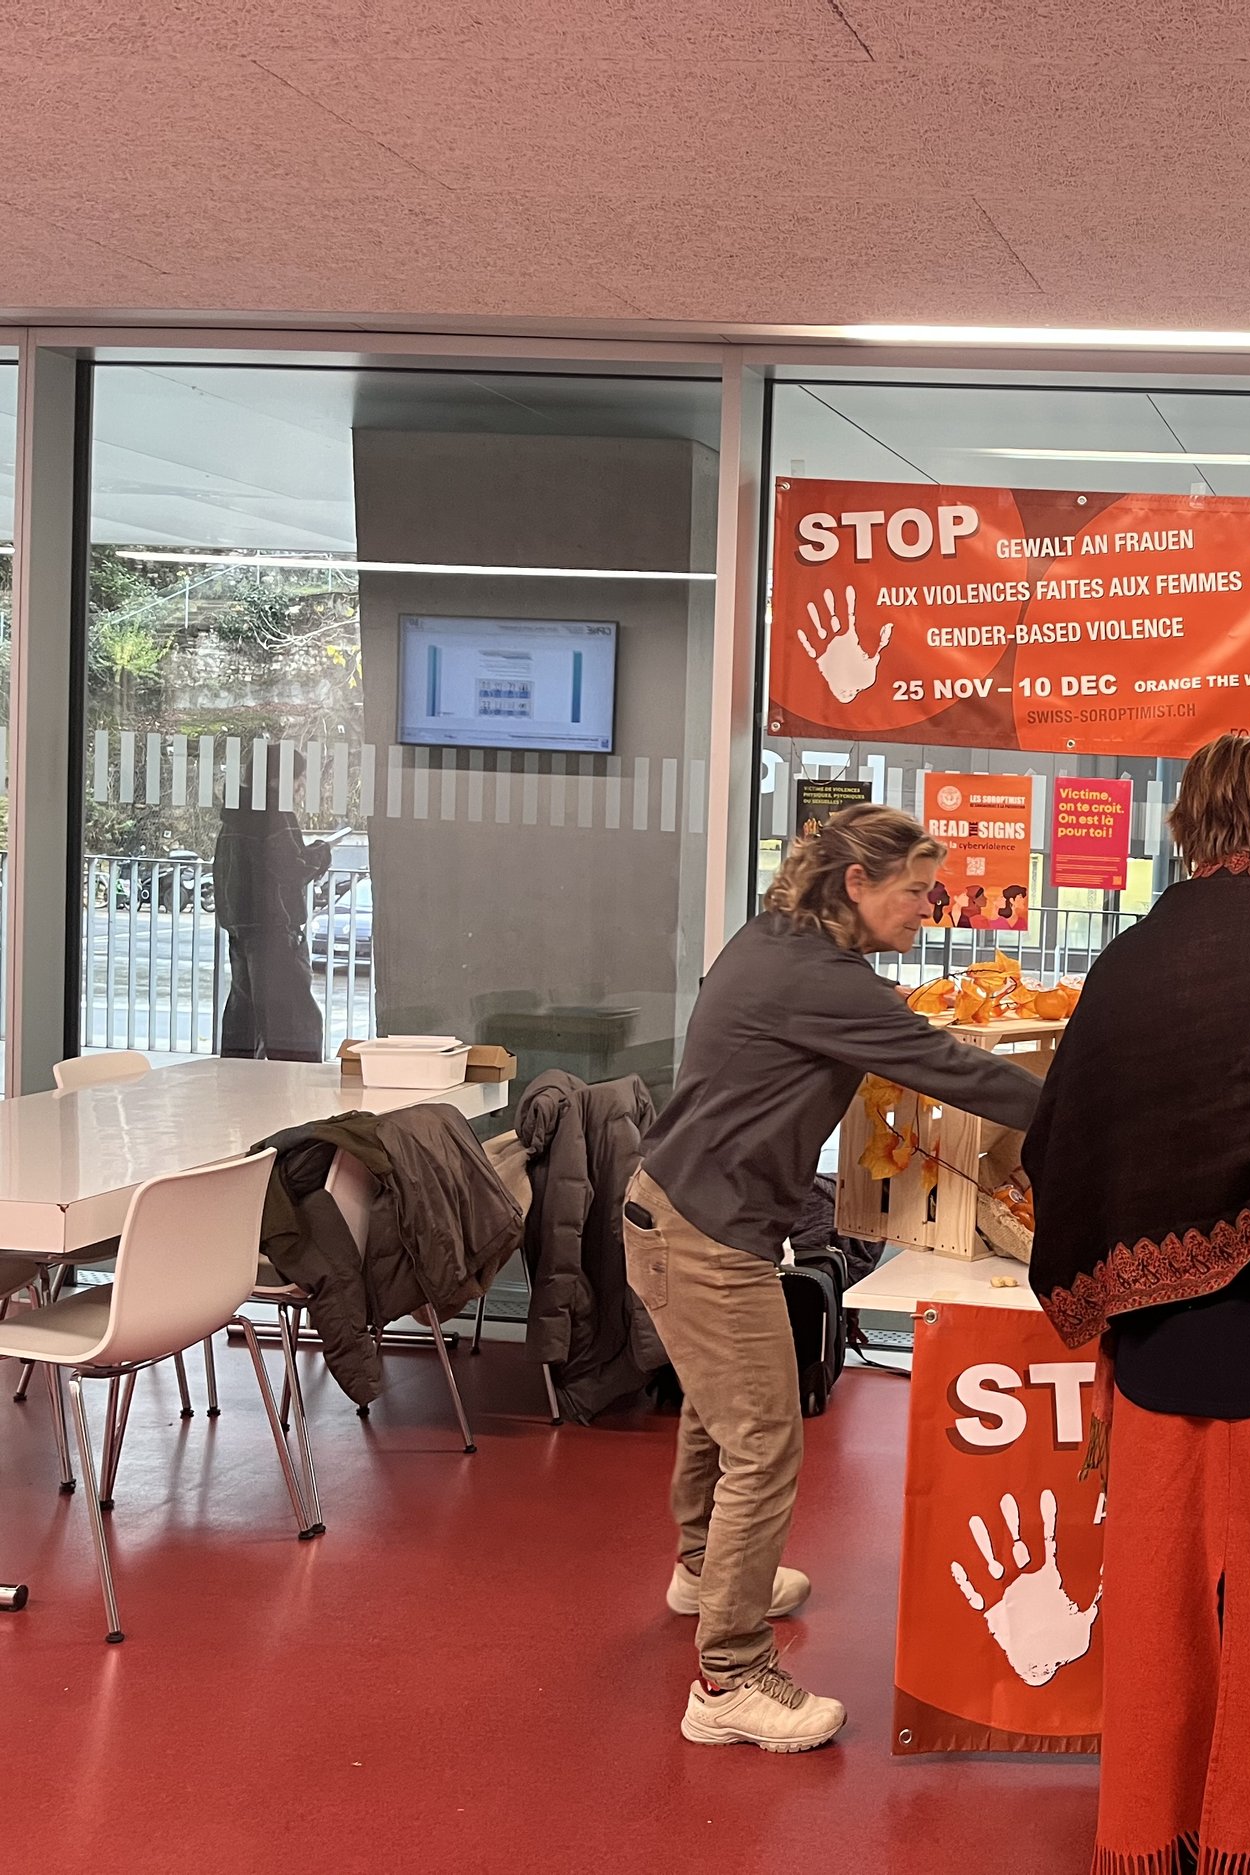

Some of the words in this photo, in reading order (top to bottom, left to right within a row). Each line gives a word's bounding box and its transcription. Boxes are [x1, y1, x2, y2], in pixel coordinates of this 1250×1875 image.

[798, 504, 980, 563] STOP
[996, 536, 1076, 559] GEWALT
[1081, 534, 1108, 555] AN
[1114, 529, 1194, 553] FRAUEN
[877, 587, 918, 606] AUX
[923, 581, 1031, 605] VIOLENCES
[1036, 578, 1105, 601] FAITES
[1109, 576, 1151, 597] AUX
[1156, 571, 1243, 595] FEMMES
[927, 622, 1081, 648] GENDER-BASED
[1086, 617, 1185, 641] VIOLENCE
[892, 680, 925, 701] 25
[933, 678, 993, 699] NOV
[1018, 677, 1051, 697] 10
[1061, 674, 1118, 696] DEC
[1134, 676, 1202, 693] ORANGE
[1206, 674, 1240, 688] THE
[1026, 703, 1197, 725] SWISS-SOROPTIMIST.CH
[1059, 788, 1112, 802] Victime,
[1058, 803, 1075, 811] on
[1076, 802, 1090, 812] te
[1091, 803, 1124, 813] croit.
[928, 819, 970, 838] READ
[978, 821, 1026, 840] SIGNS
[1058, 813, 1076, 824] On
[1078, 815, 1099, 825] est
[1057, 827, 1088, 838] pour
[1089, 827, 1107, 838] toi
[958, 841, 1016, 851] cyberviolence
[954, 1361, 1097, 1447] ST
